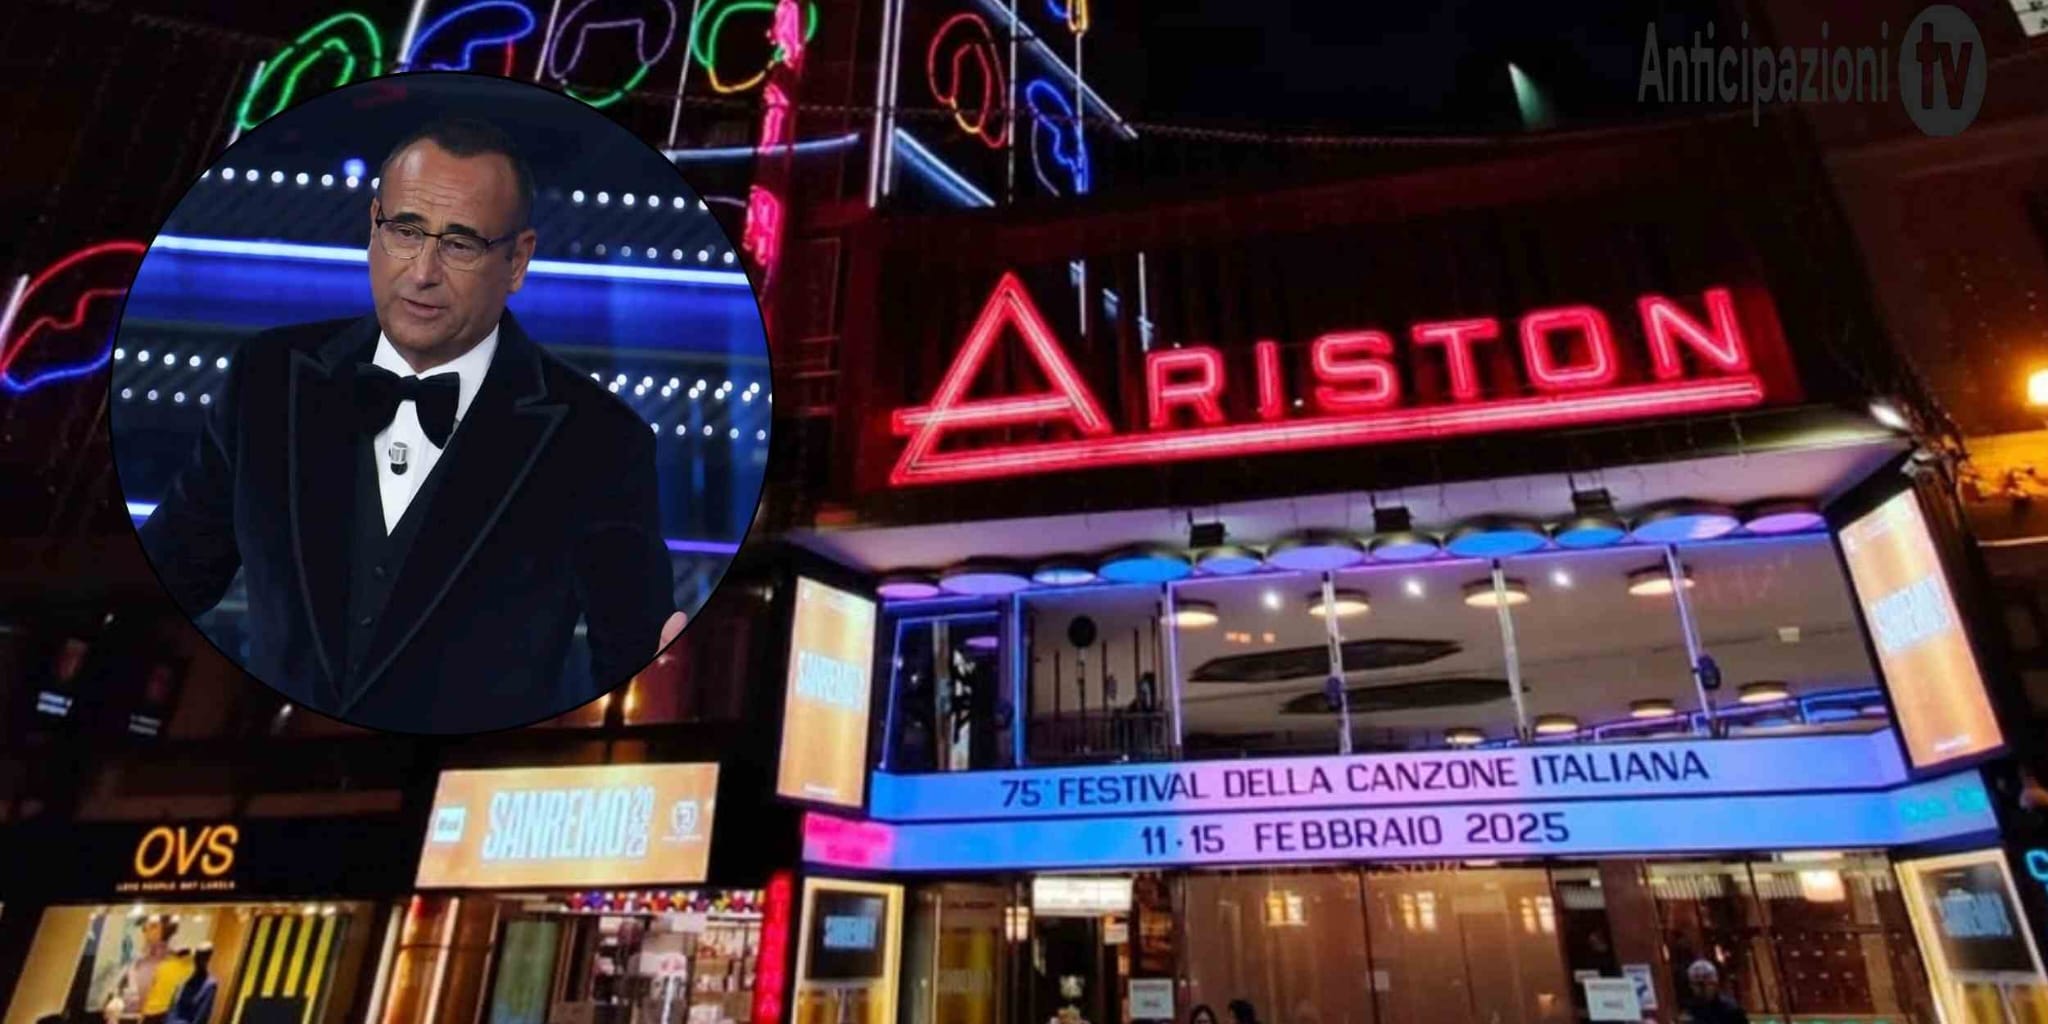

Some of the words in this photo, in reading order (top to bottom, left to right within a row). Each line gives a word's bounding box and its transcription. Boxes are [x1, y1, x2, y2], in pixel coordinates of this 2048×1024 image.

[891, 272, 1763, 485] ARISTON
[1057, 771, 1210, 807] FESTIVAL
[1223, 764, 1334, 800] DELLA
[1346, 756, 1519, 793] CANZONE
[1531, 749, 1711, 785] ITALIANA
[135, 825, 239, 877] OVS
[481, 789, 631, 859] SANREMO
[1254, 815, 1443, 853] FEBBRAIO
[1465, 811, 1570, 844] 2025
